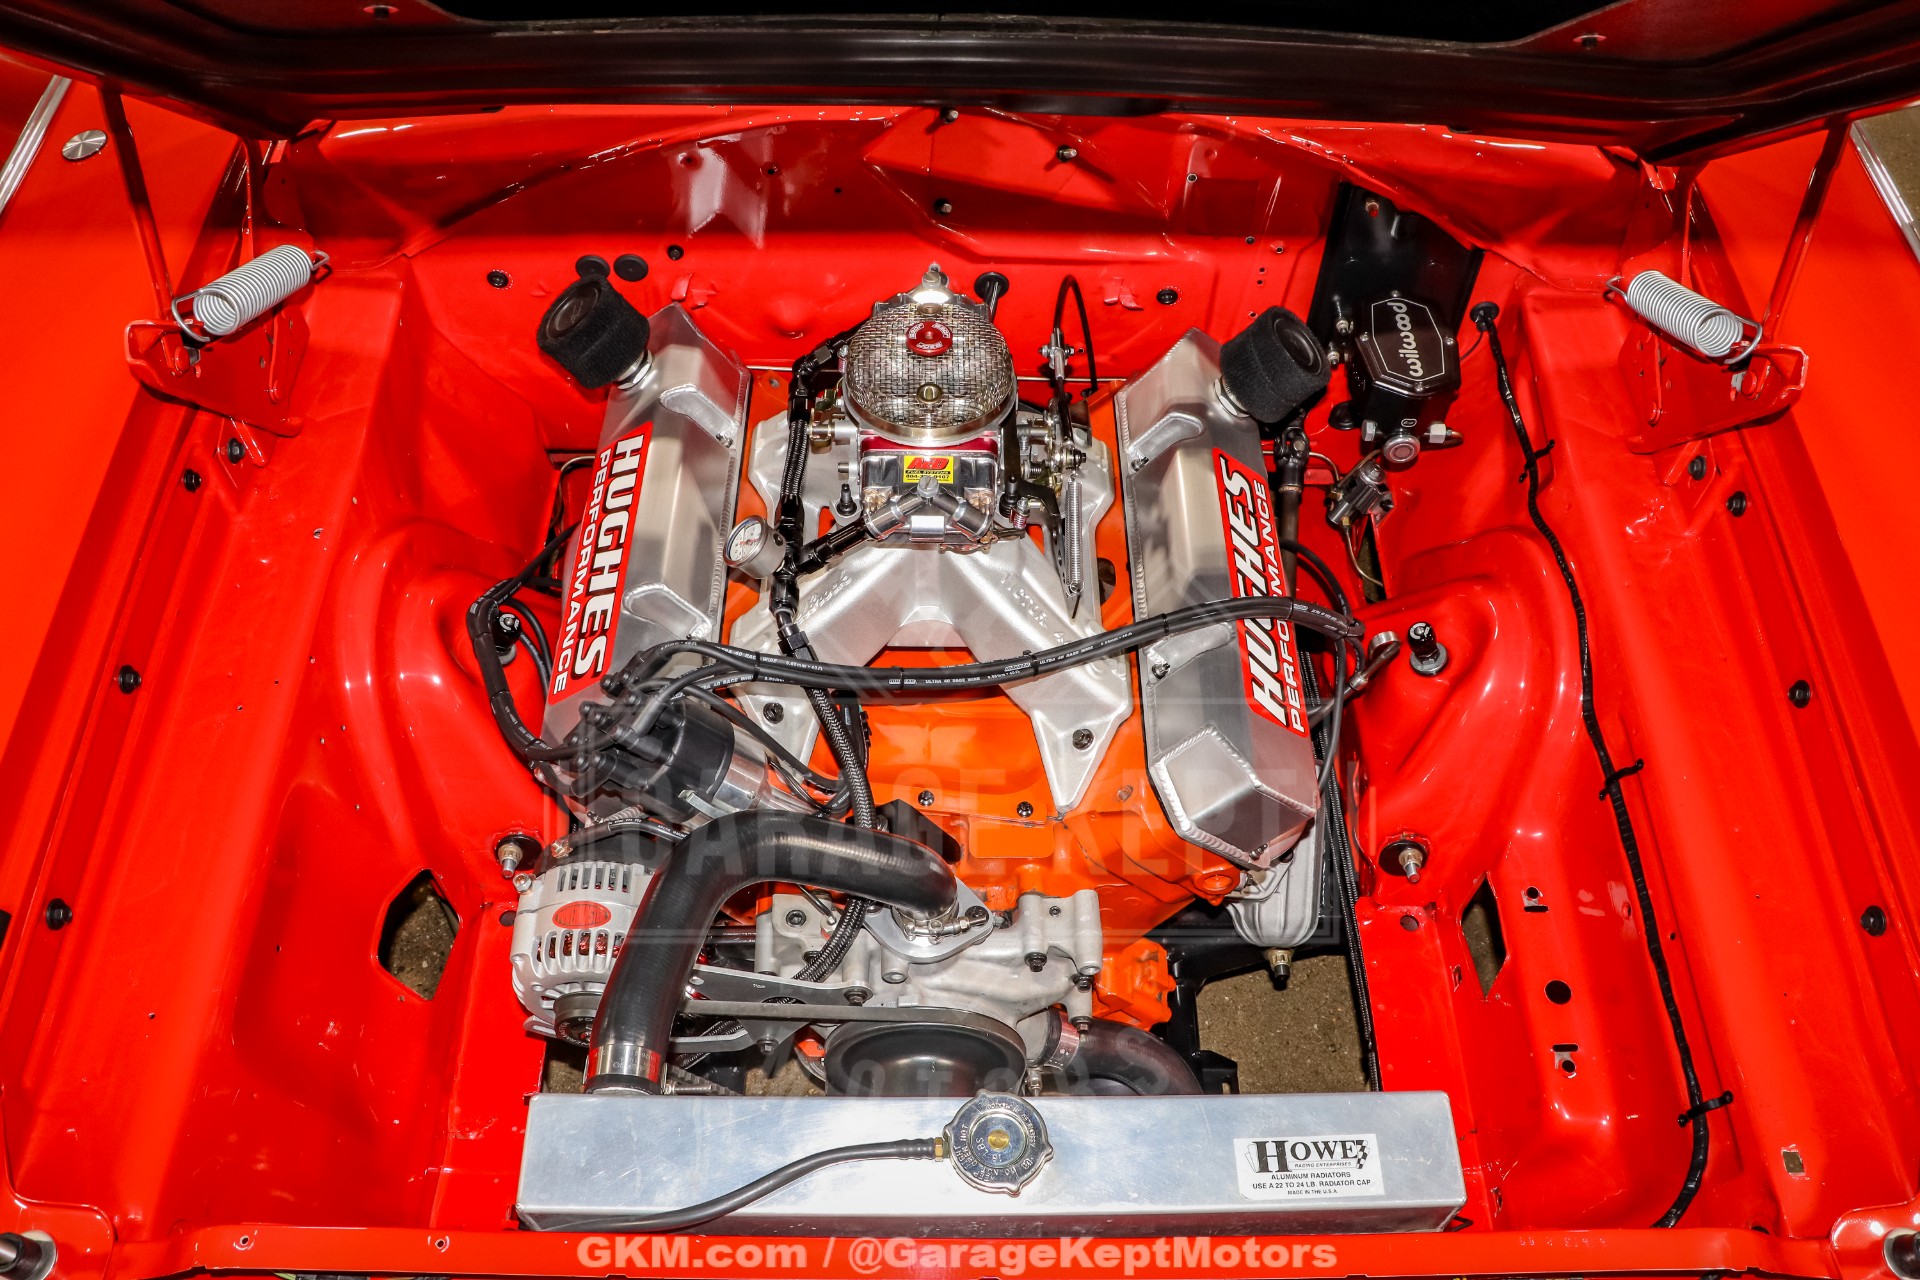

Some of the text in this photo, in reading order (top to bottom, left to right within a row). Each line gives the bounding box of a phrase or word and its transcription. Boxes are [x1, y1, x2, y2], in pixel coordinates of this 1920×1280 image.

[1387, 301, 1424, 377] wilwood
[553, 448, 611, 695] PERFORMANCE
[571, 435, 644, 677] HUGHES
[1253, 478, 1305, 733] PERFOMANCE
[1252, 1140, 1358, 1173] HOWE
[1319, 1179, 1355, 1187] RADIATOR
